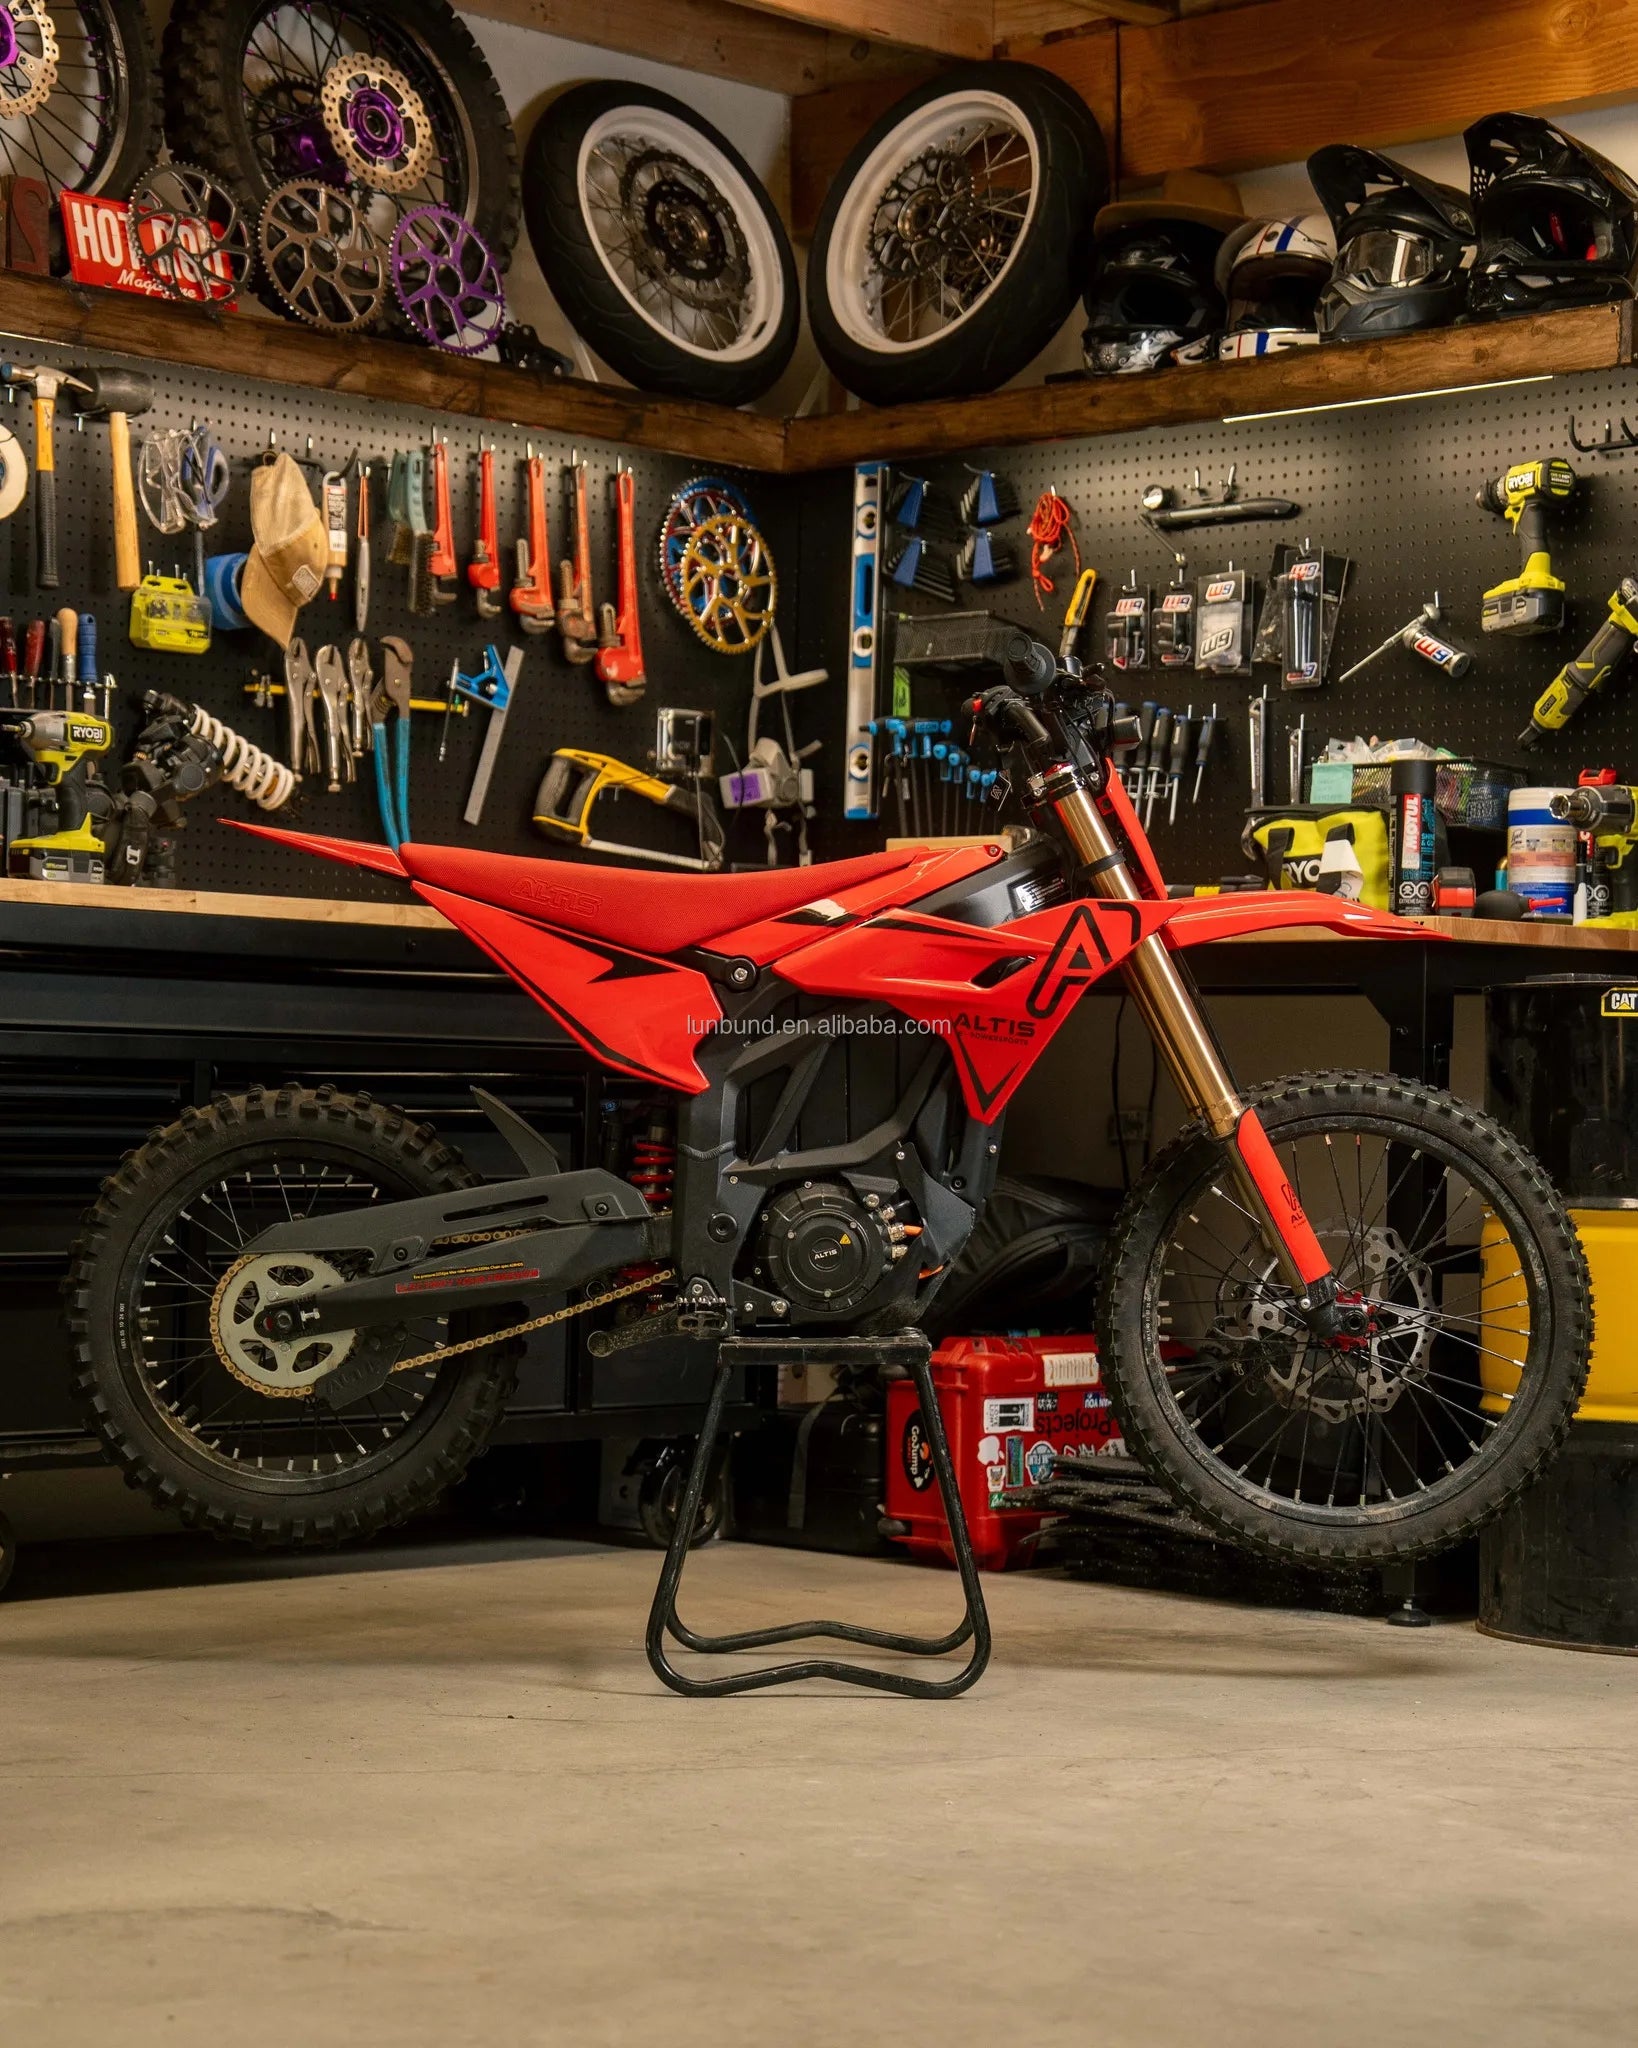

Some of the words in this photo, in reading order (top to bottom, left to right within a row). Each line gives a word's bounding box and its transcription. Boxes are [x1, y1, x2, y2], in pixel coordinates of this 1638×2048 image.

[71, 202, 141, 270] HOT
[117, 269, 197, 299] Magane
[1508, 472, 1534, 489] RYOBI
[73, 726, 103, 739] RYOBI
[1406, 797, 1419, 850] MOTUL
[1282, 859, 1321, 884] RYO
[1611, 993, 1638, 1010] CAT
[953, 1013, 1036, 1038] ALTIS
[814, 1249, 838, 1260] ALTIS
[1035, 1408, 1112, 1440] Projects
[910, 1426, 920, 1475] GoJump
